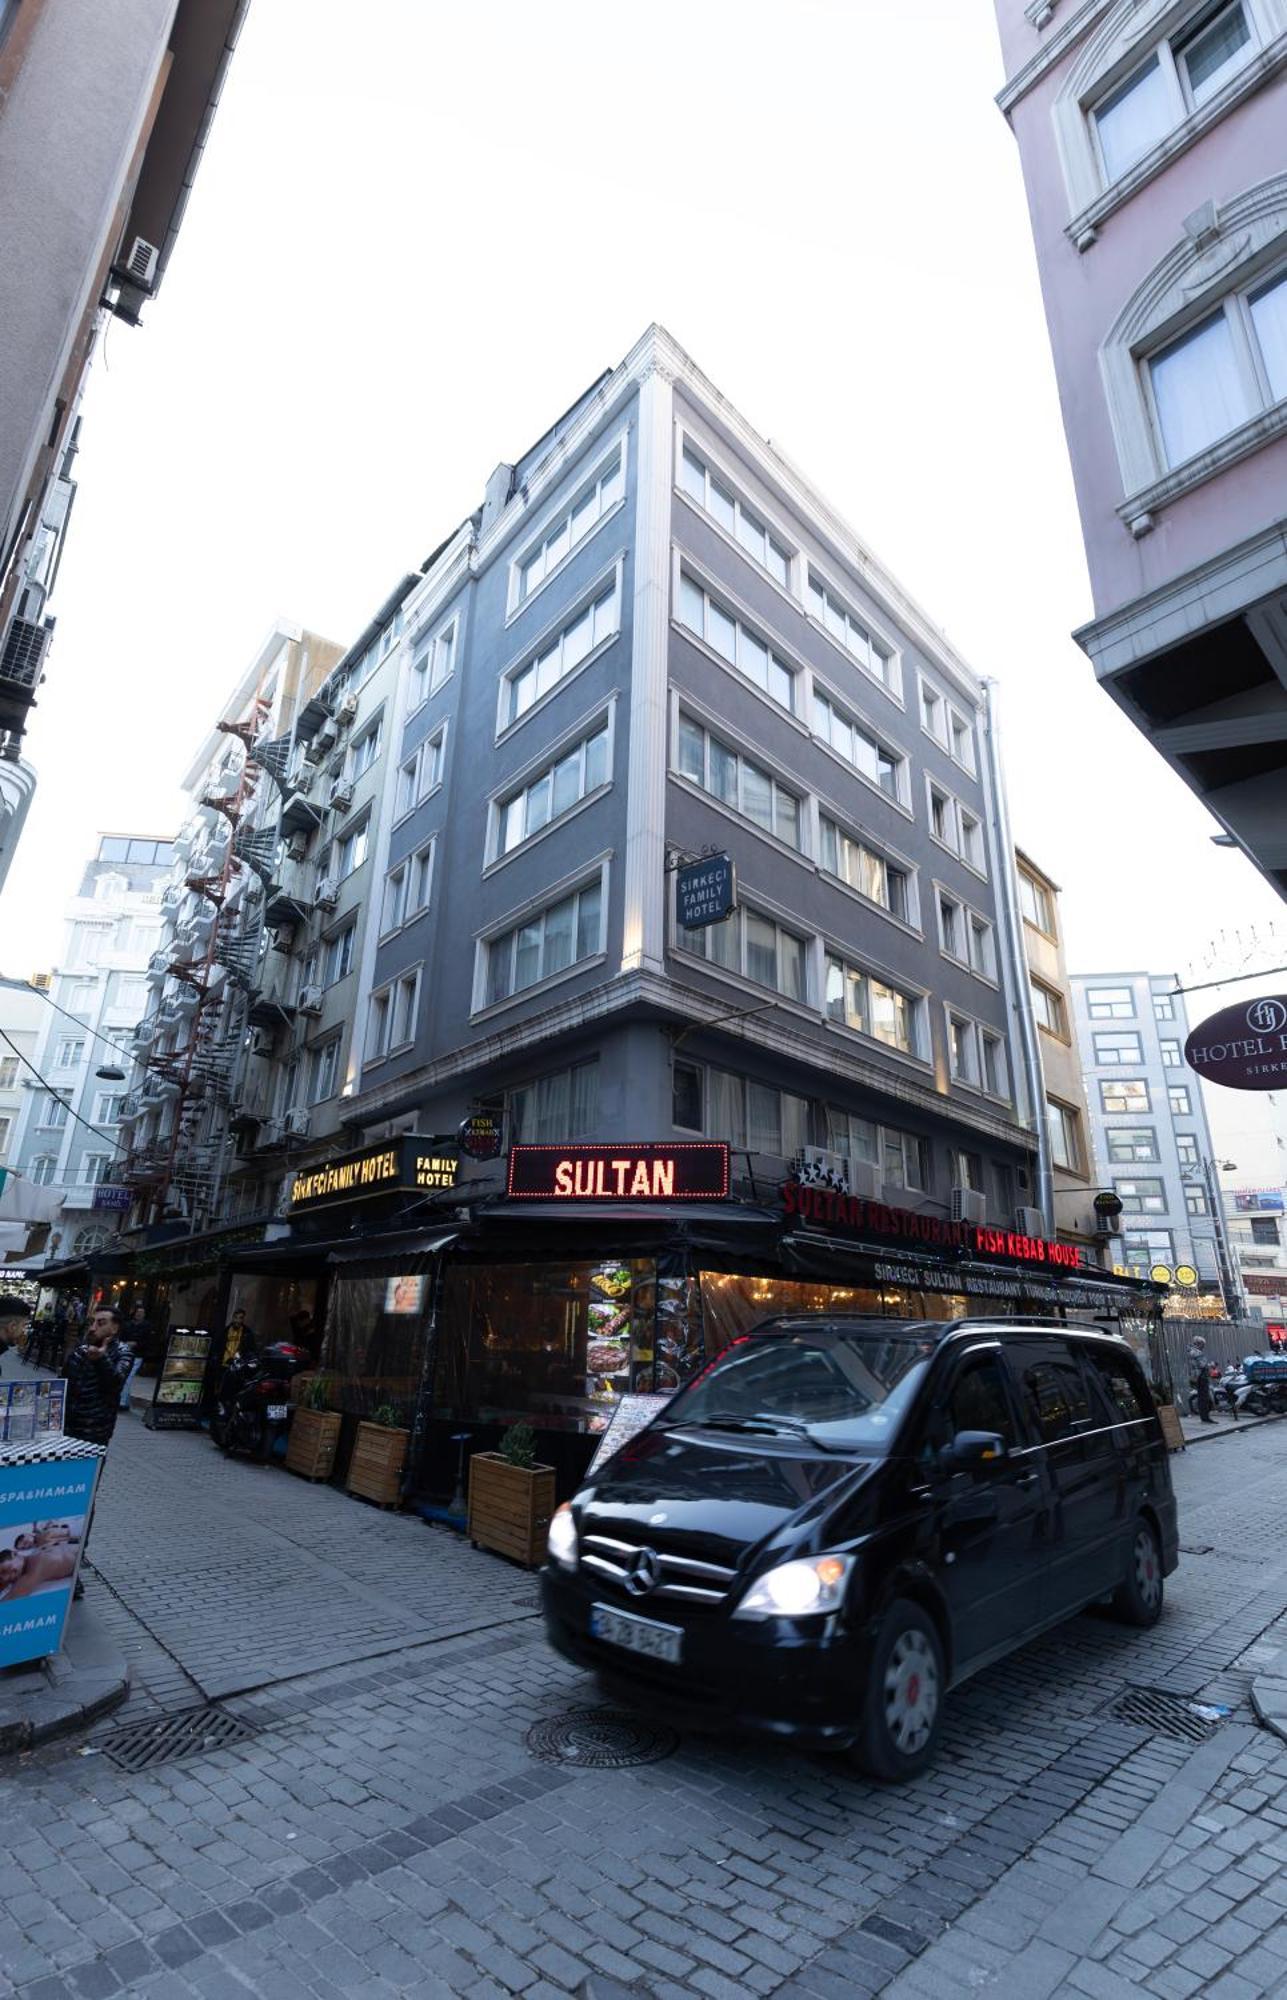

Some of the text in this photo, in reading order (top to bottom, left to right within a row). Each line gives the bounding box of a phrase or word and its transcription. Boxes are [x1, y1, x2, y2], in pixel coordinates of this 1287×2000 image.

[681, 869, 726, 893] SIRKECI
[683, 885, 722, 906] FAMILY
[686, 901, 721, 919] HOTEL
[1191, 1037, 1273, 1065] HOTEL
[327, 1160, 362, 1193] FAMILY
[361, 1151, 396, 1184] HOTEL
[416, 1157, 458, 1173] FAMILY
[416, 1173, 455, 1187] HOTEL
[553, 1159, 675, 1196] SULTAN
[783, 1183, 1084, 1269] SULTAN RESTAURANT FISH KEBAB HOUSE
[922, 1270, 963, 1290] SULTAN
